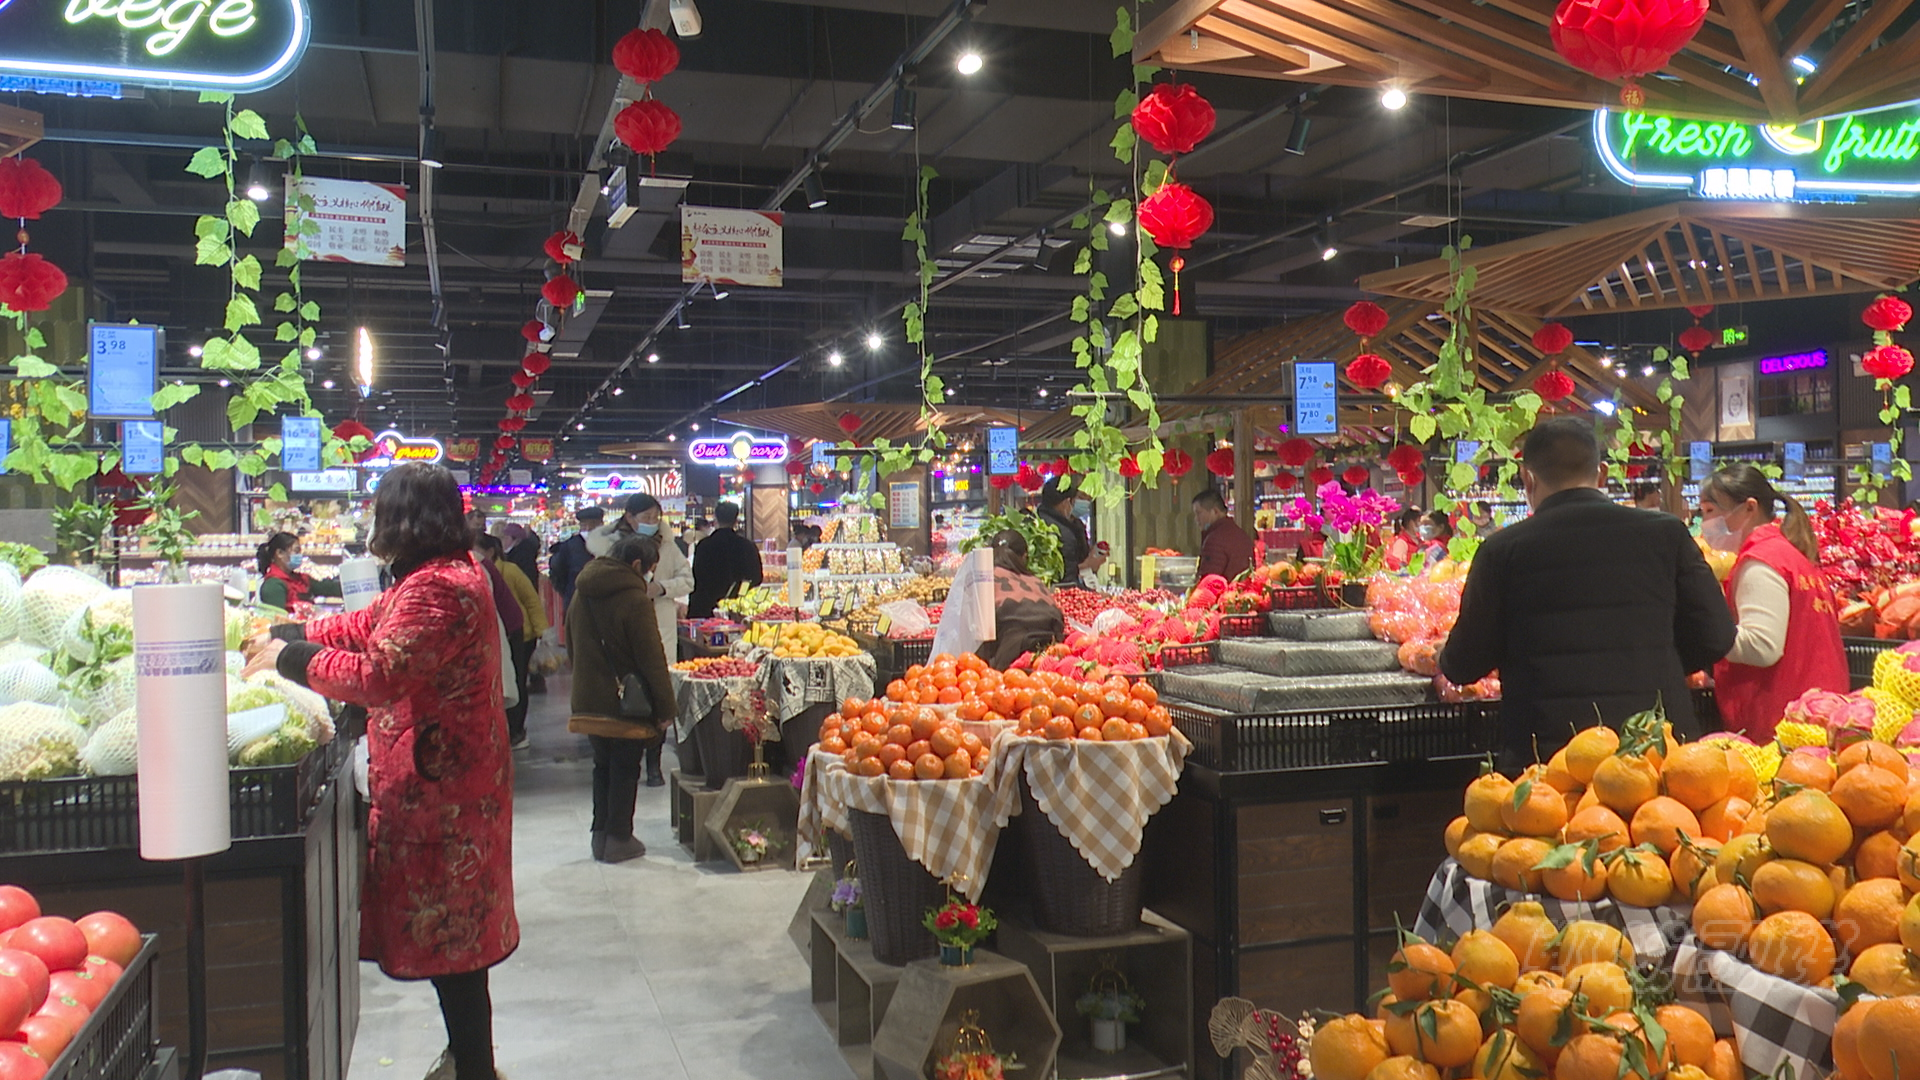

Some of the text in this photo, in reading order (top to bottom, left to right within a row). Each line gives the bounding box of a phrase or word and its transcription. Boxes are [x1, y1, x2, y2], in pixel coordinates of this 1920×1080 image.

[1625, 90, 1639, 105] 福
[1762, 350, 1827, 374] DELICIOUS
[394, 447, 438, 461] grains
[693, 444, 785, 459] Bulk cargo
